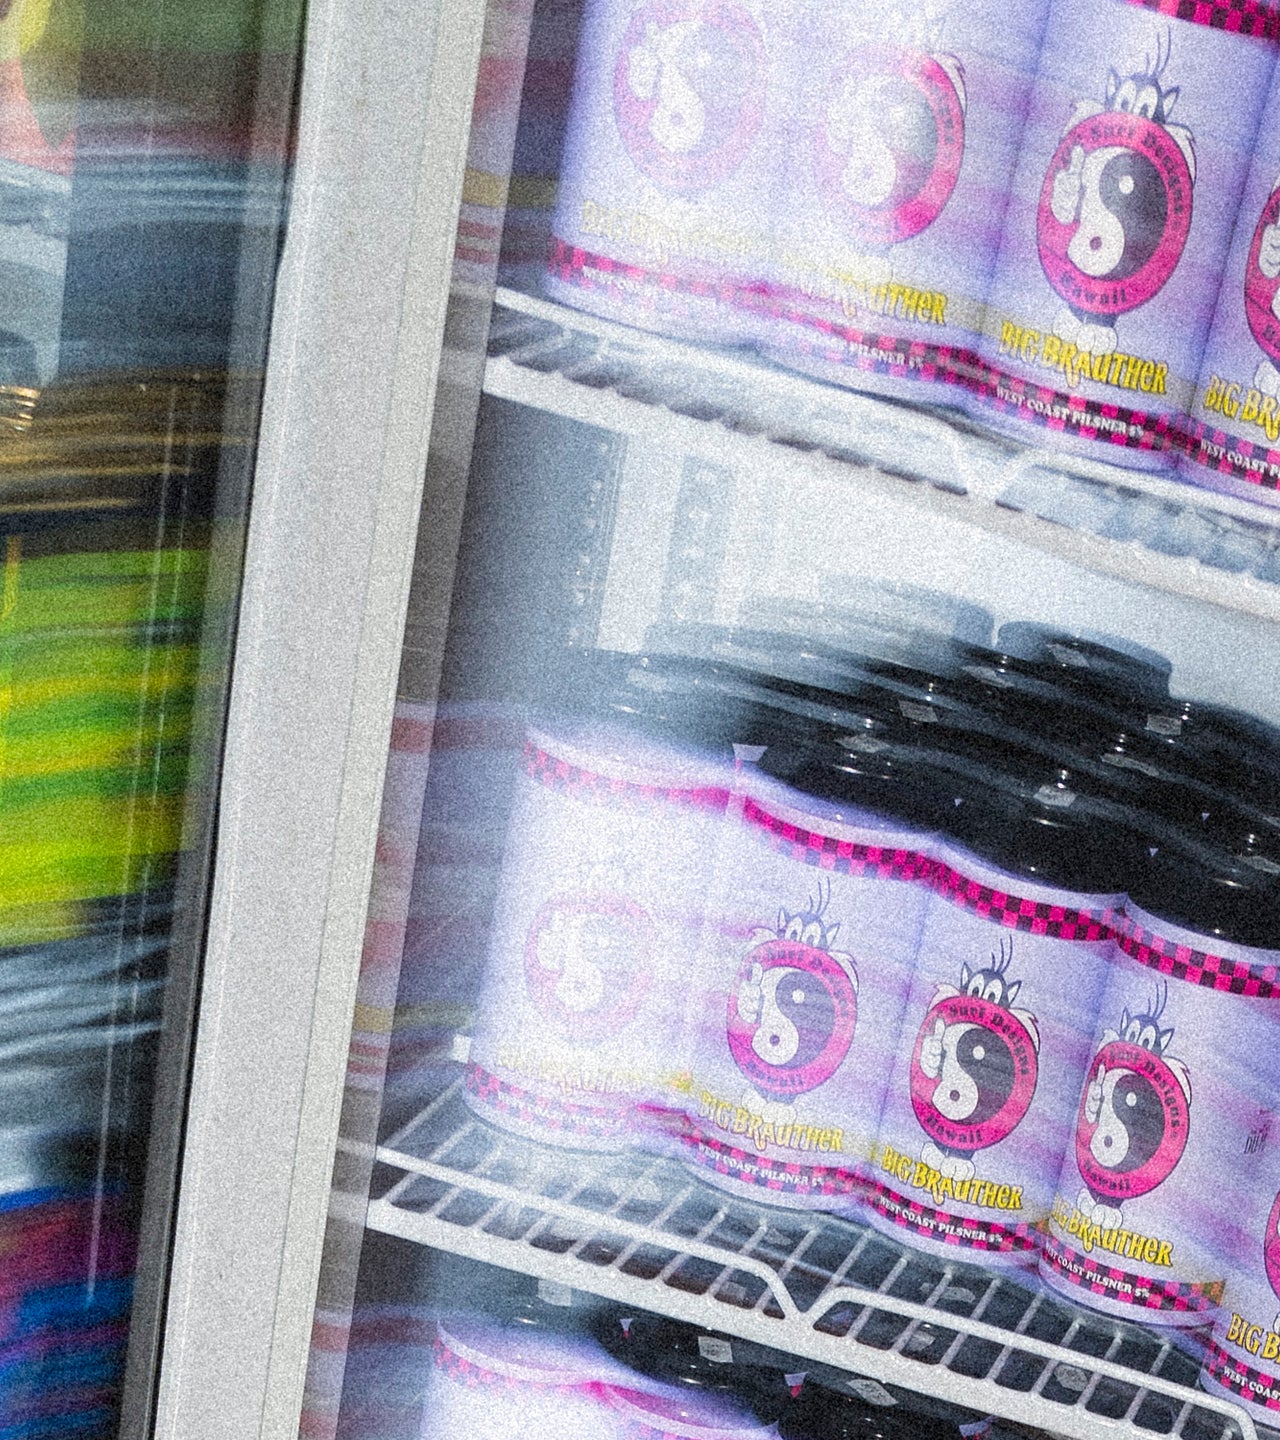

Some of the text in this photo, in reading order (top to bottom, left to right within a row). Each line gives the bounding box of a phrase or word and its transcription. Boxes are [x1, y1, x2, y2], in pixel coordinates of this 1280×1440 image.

[1000, 320, 1169, 396] BIG BRAUTHER
[1204, 373, 1242, 420] BIG
[881, 1144, 1024, 1211] BIG BRAUTHER
[901, 1207, 937, 1230] COAST
[937, 1219, 987, 1241] PILSNER
[1067, 1208, 1174, 1268] BRAUTHER
[1225, 1312, 1265, 1354] BIG
[1224, 1365, 1250, 1389] WEST
